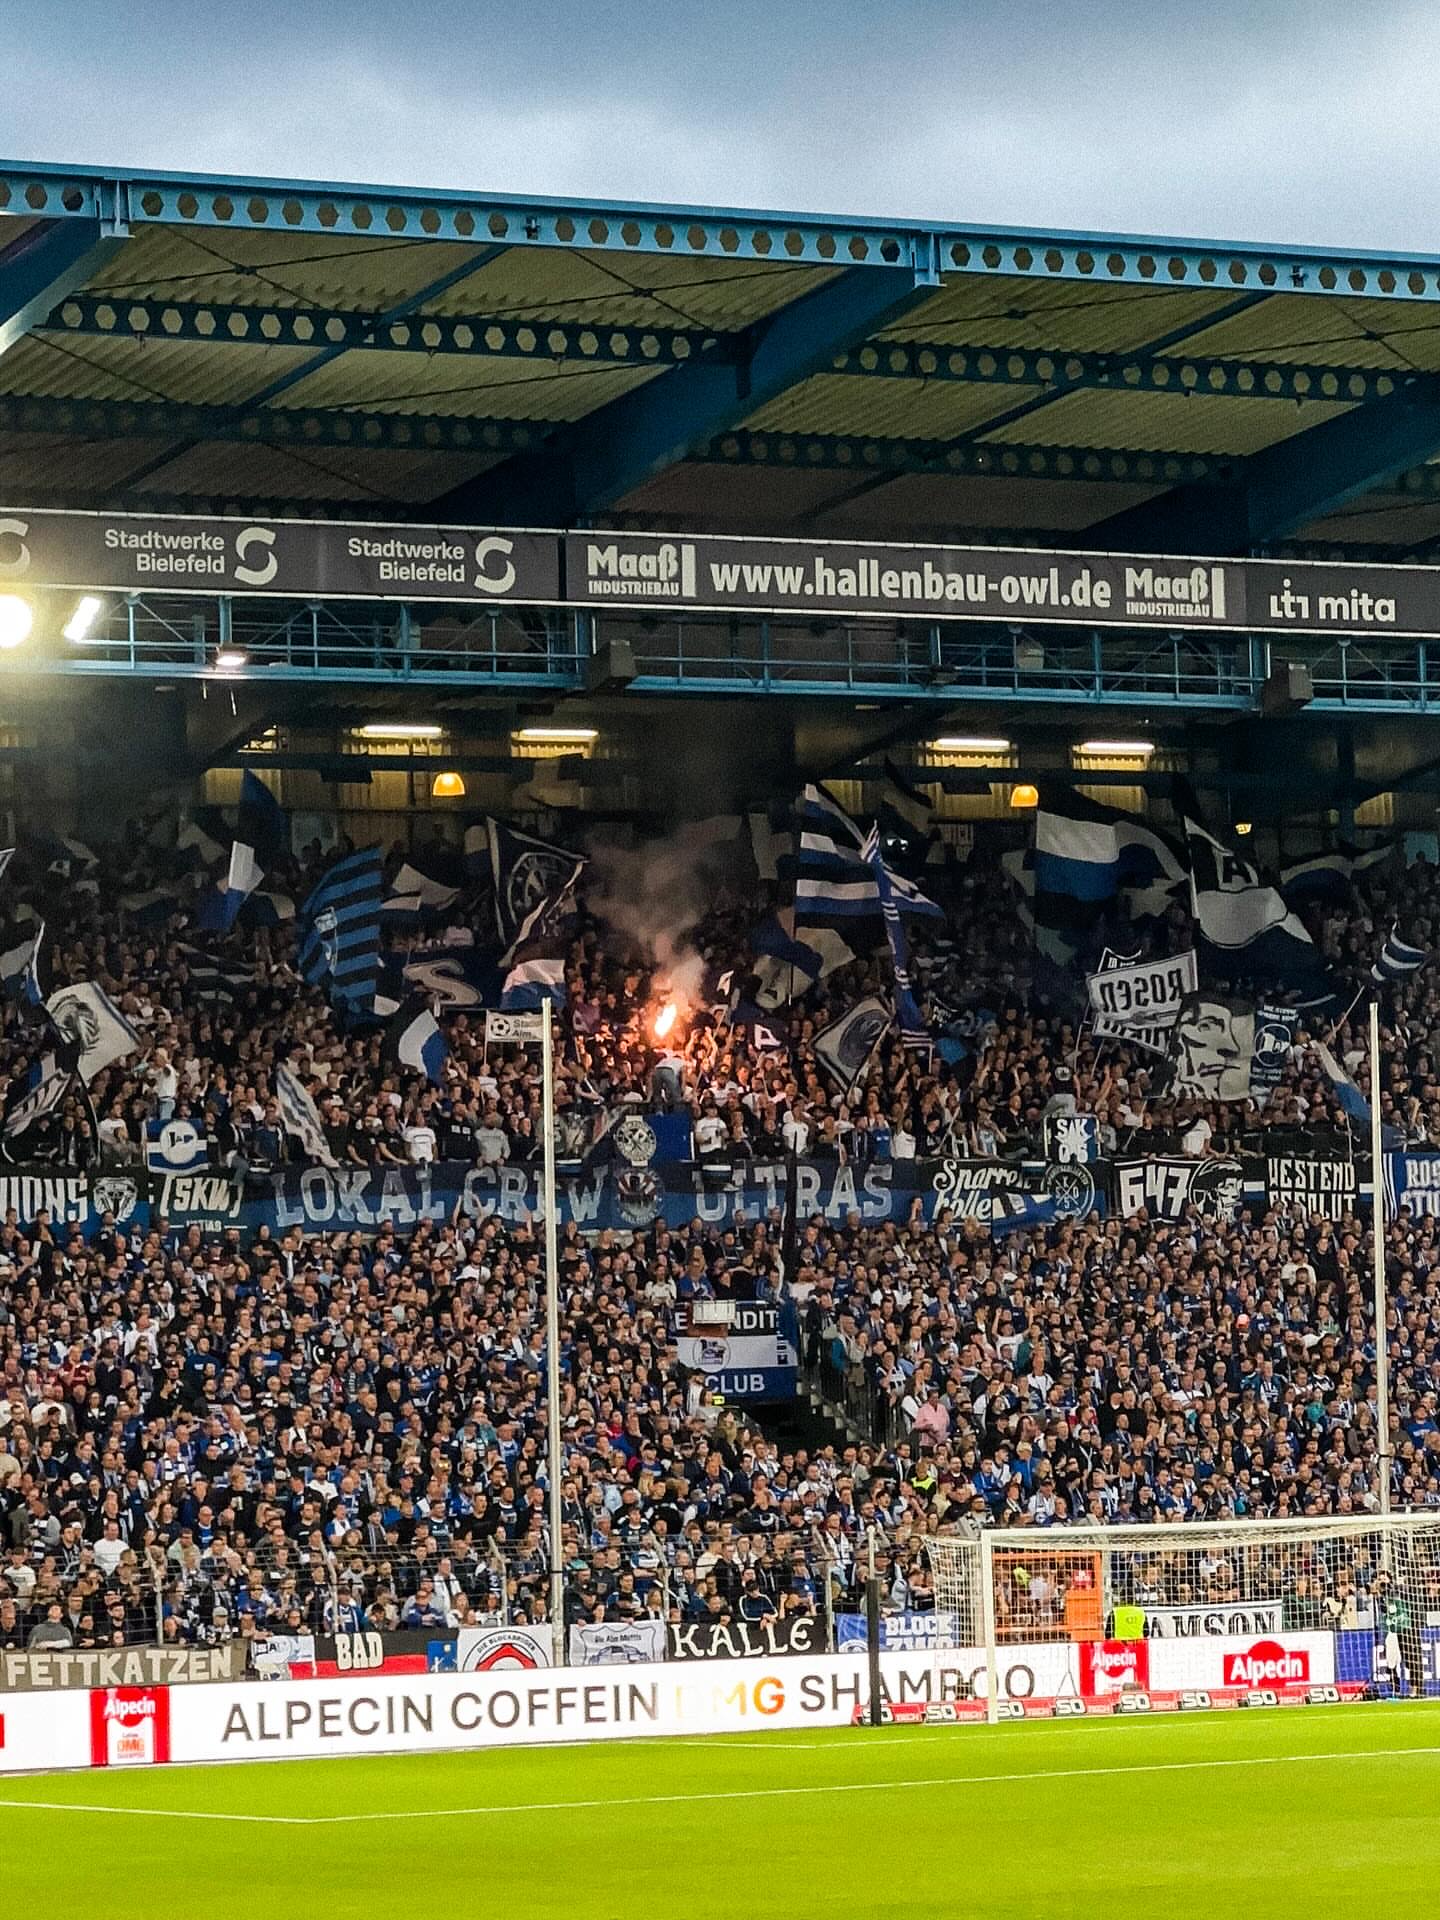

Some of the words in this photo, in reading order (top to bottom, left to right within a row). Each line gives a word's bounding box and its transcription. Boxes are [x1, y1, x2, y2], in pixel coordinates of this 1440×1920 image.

[104, 529, 225, 550] Stadtwerke
[348, 538, 465, 560] Stadtwerke
[136, 553, 225, 574] Bielefeld
[379, 562, 465, 582] Bielefeld
[587, 543, 679, 581] Maaß
[588, 580, 680, 596] INDUSTRIEBAU
[710, 556, 1112, 608] www.hallenbau-owl.de
[1125, 567, 1208, 602] Maaß
[1126, 601, 1210, 617] INDUSTRIEBAU
[1319, 588, 1396, 622] mita
[1267, 1158, 1357, 1191] WESTEND
[271, 1165, 446, 1228] LOKAL
[705, 1374, 765, 1394] CLUB
[671, 1617, 814, 1657] KALLE
[885, 1615, 954, 1636] BLOCK
[6, 1645, 232, 1687] FETTKATZEN
[335, 1631, 383, 1670] BAD
[1092, 1650, 1137, 1668] Alpecin
[1230, 1654, 1304, 1686] Alpecin
[104, 1696, 156, 1721] Alpecin
[221, 1694, 433, 1742] ALPECIN
[451, 1682, 658, 1731] COFFEIN
